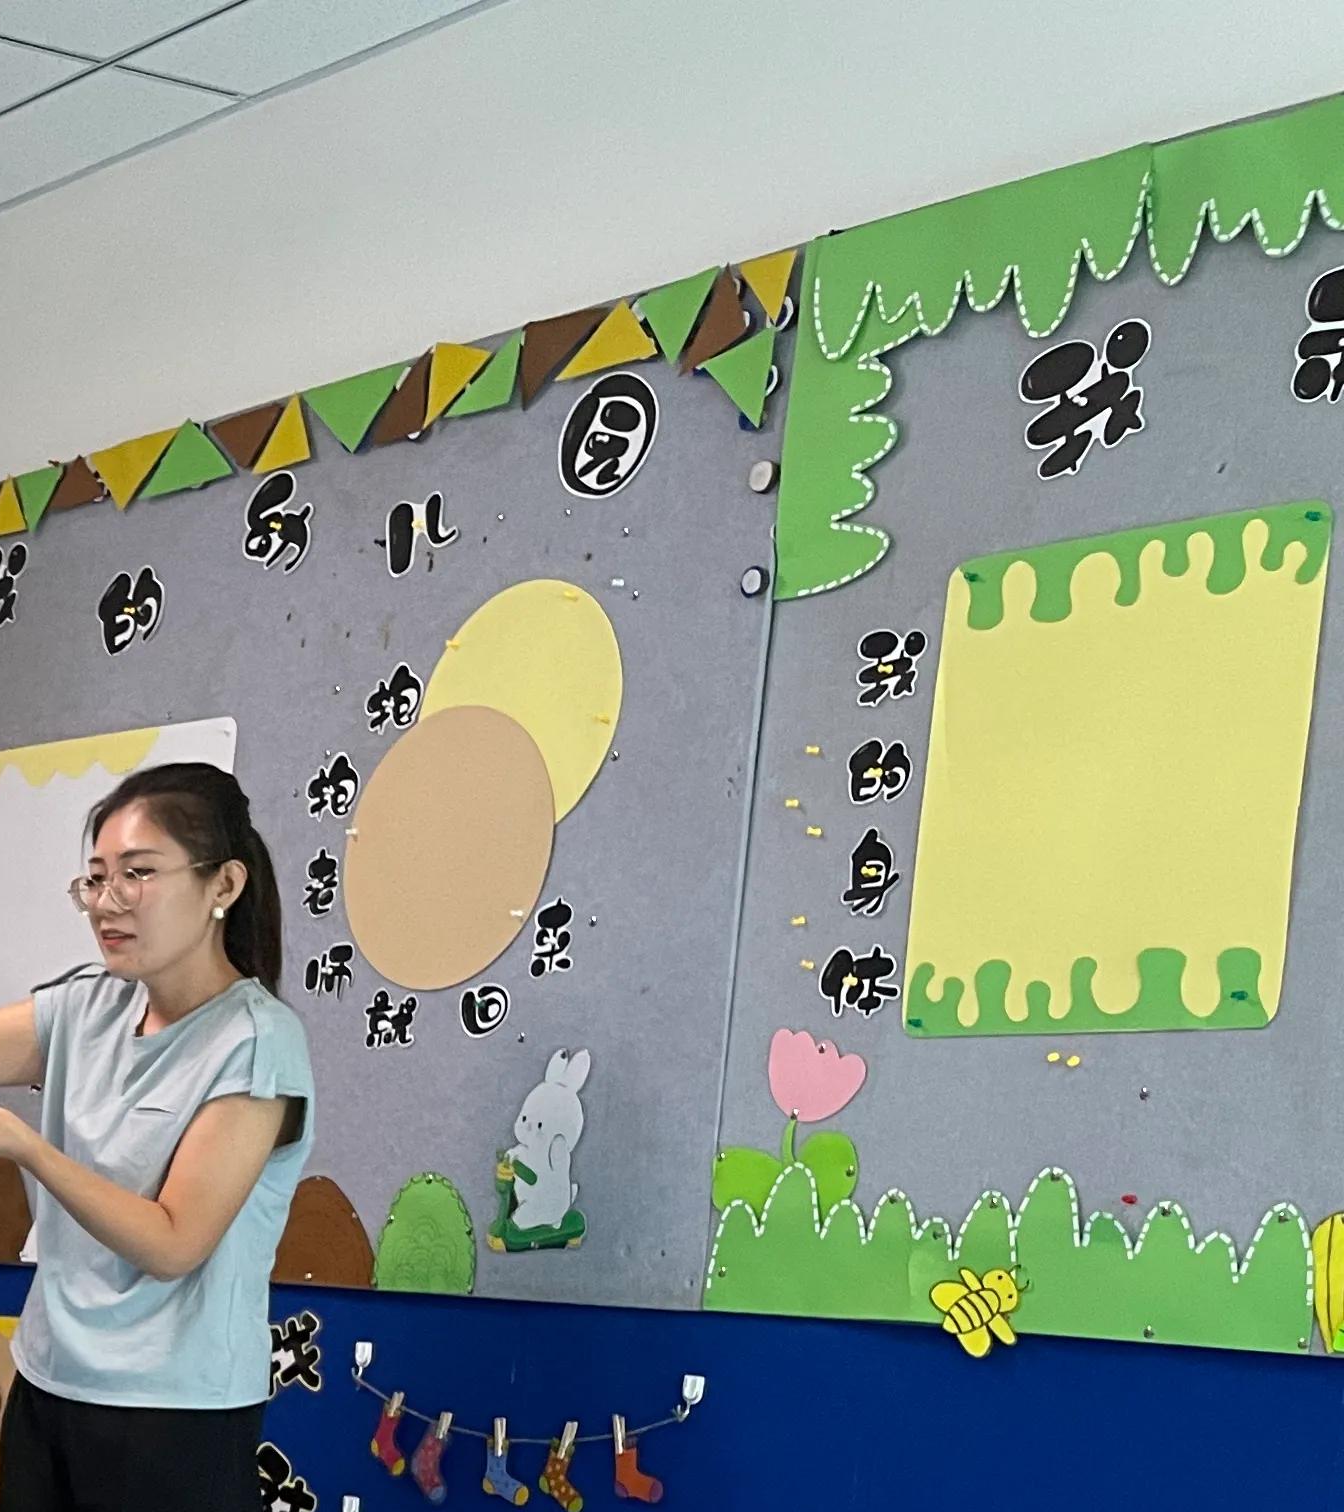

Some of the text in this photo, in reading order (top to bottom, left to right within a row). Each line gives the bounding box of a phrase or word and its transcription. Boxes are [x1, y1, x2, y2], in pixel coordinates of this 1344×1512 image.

[303, 665, 572, 1047] 抱抱老师就回来
[823, 630, 925, 1016] 我的身体
